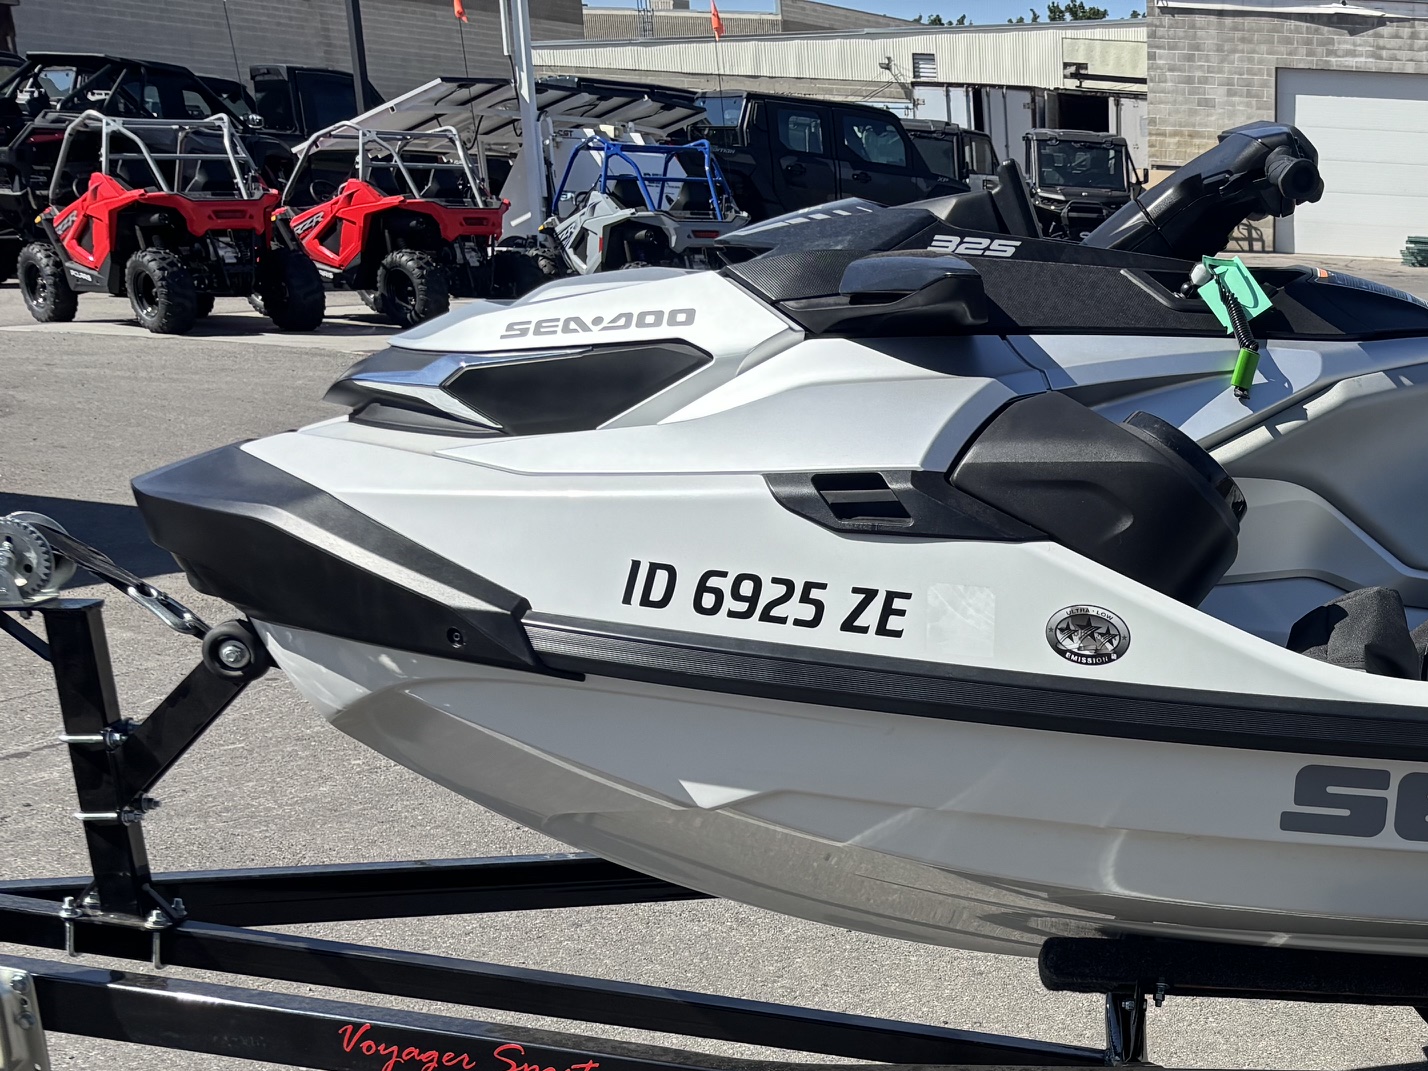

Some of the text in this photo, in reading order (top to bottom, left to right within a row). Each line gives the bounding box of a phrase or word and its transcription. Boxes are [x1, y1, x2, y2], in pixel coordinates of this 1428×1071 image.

[293, 211, 325, 235] RZR
[926, 234, 1022, 258] 325
[621, 558, 914, 639] ID 6925 ZE
[1065, 607, 1114, 621] ULTRA LOW
[1065, 652, 1109, 664] EMISSION
